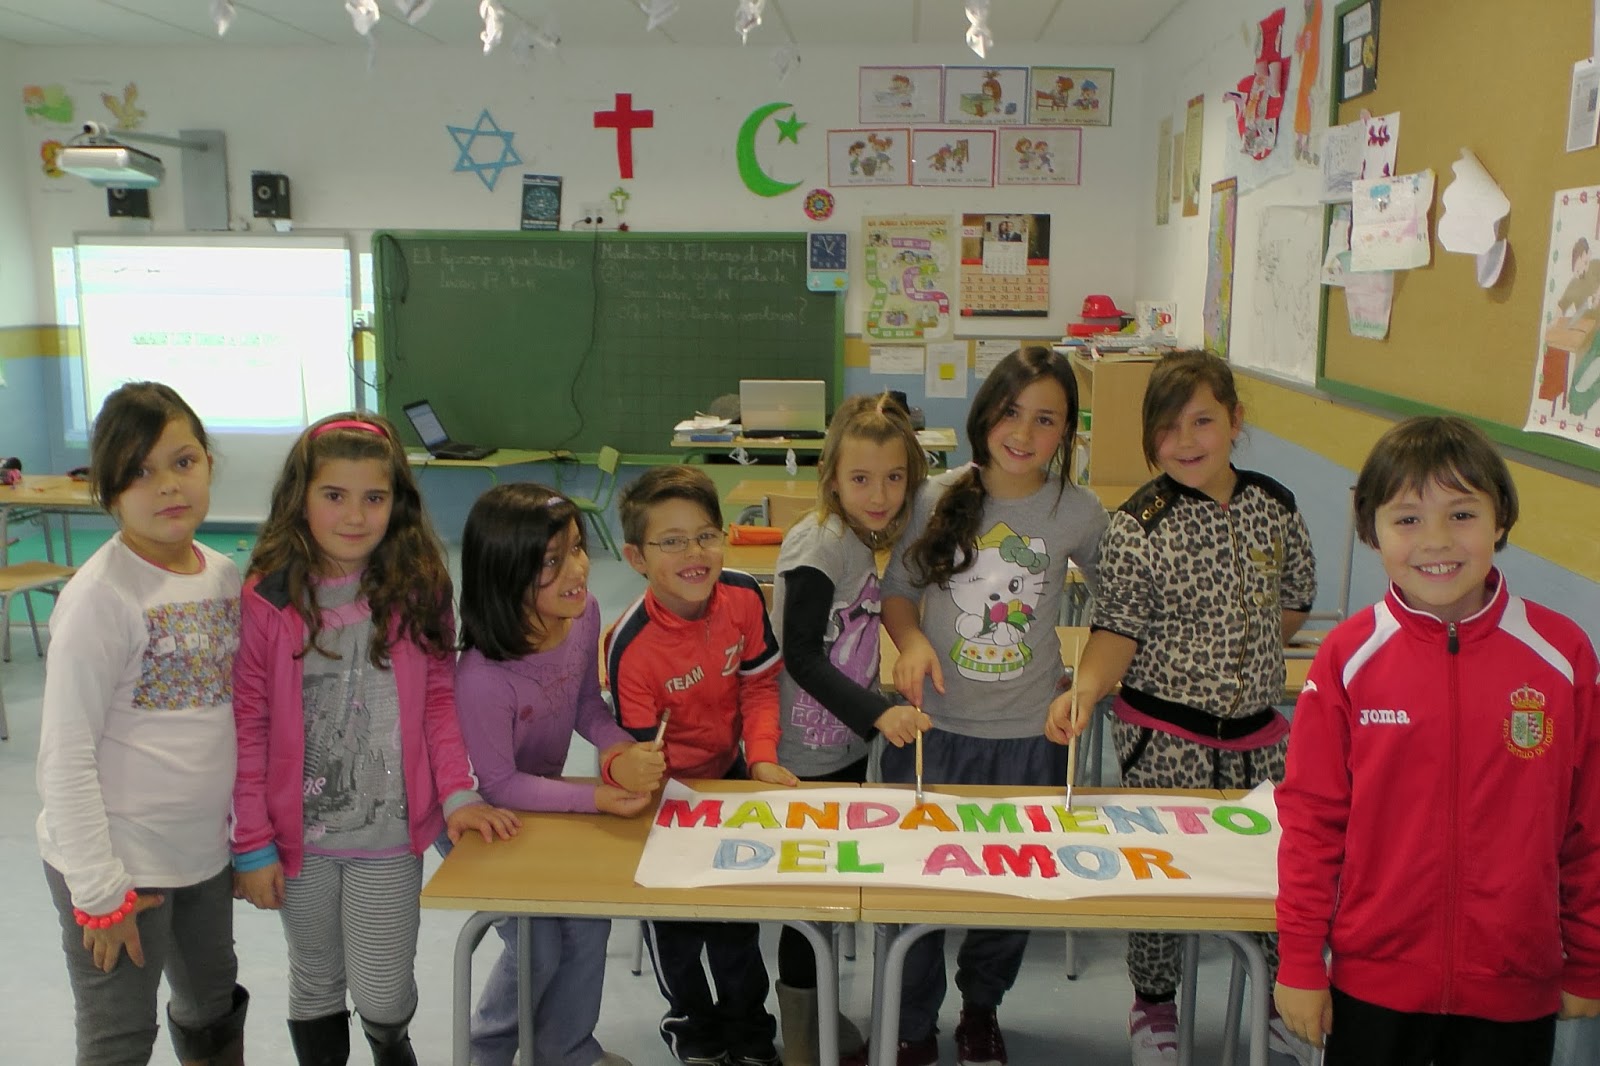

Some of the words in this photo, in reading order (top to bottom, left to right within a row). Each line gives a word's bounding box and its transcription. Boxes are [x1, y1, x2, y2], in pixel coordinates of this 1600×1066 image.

[665, 665, 704, 694] TEAM
[655, 798, 1273, 836] MANDAMIENTO
[712, 839, 885, 873] DEL
[920, 843, 1192, 881] AMOR
